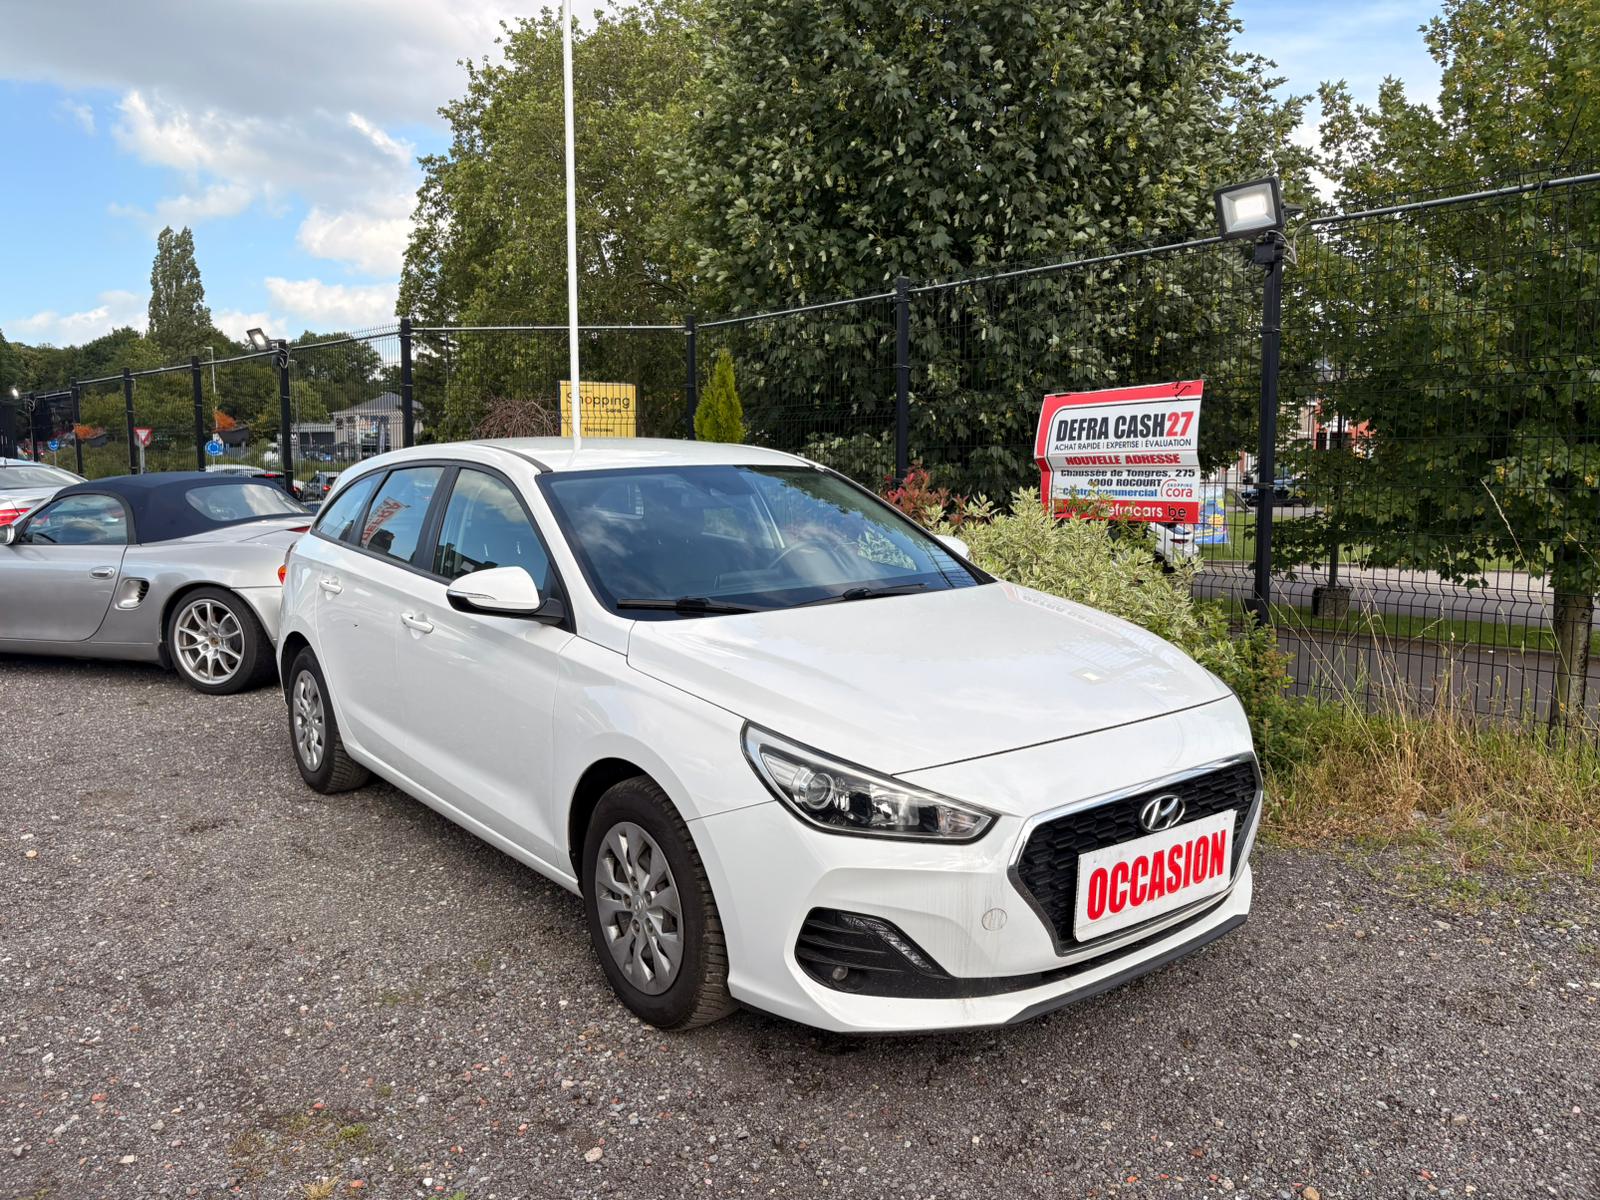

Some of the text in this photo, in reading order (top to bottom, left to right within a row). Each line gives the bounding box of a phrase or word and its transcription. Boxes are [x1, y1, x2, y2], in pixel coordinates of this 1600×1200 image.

[1056, 411, 1194, 442] DEFRA CASH27
[1054, 438, 1192, 451] ACHAT RAPIDE EXPERTISE ÉVALUATION
[1065, 453, 1181, 465] NOUVELLE ADRESSE
[1060, 469, 1195, 478] Chaussée de Tongres, 275
[1116, 478, 1162, 487] ROCOURT
[1165, 488, 1193, 498] cora
[1086, 829, 1227, 921] OCCASION
